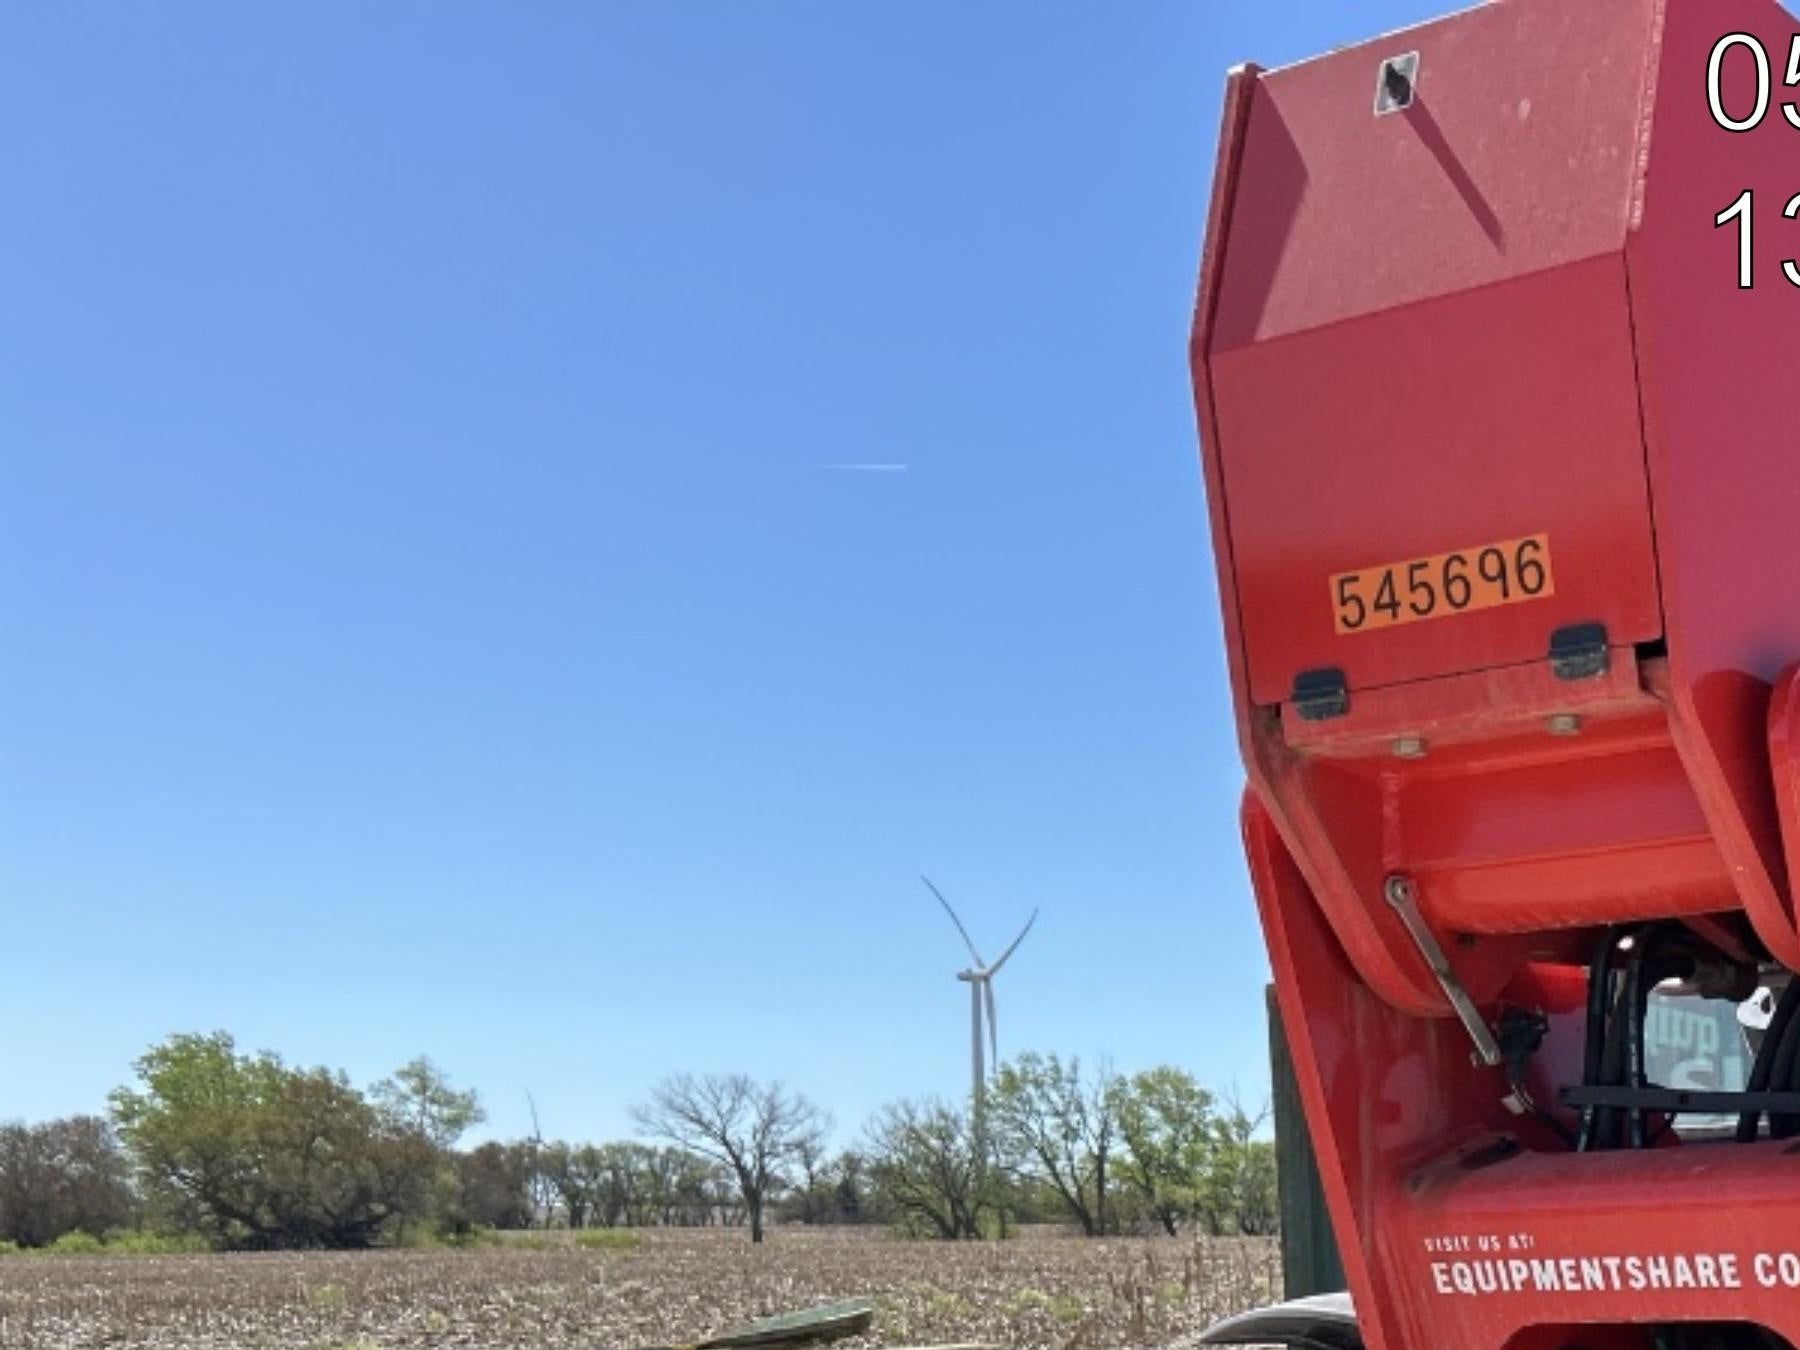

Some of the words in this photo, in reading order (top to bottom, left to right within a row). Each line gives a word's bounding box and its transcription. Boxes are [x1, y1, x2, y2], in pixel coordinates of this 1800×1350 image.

[1337, 539, 1546, 629] 545696
[1424, 1234, 1471, 1252] VISIT
[1478, 1234, 1501, 1252] US
